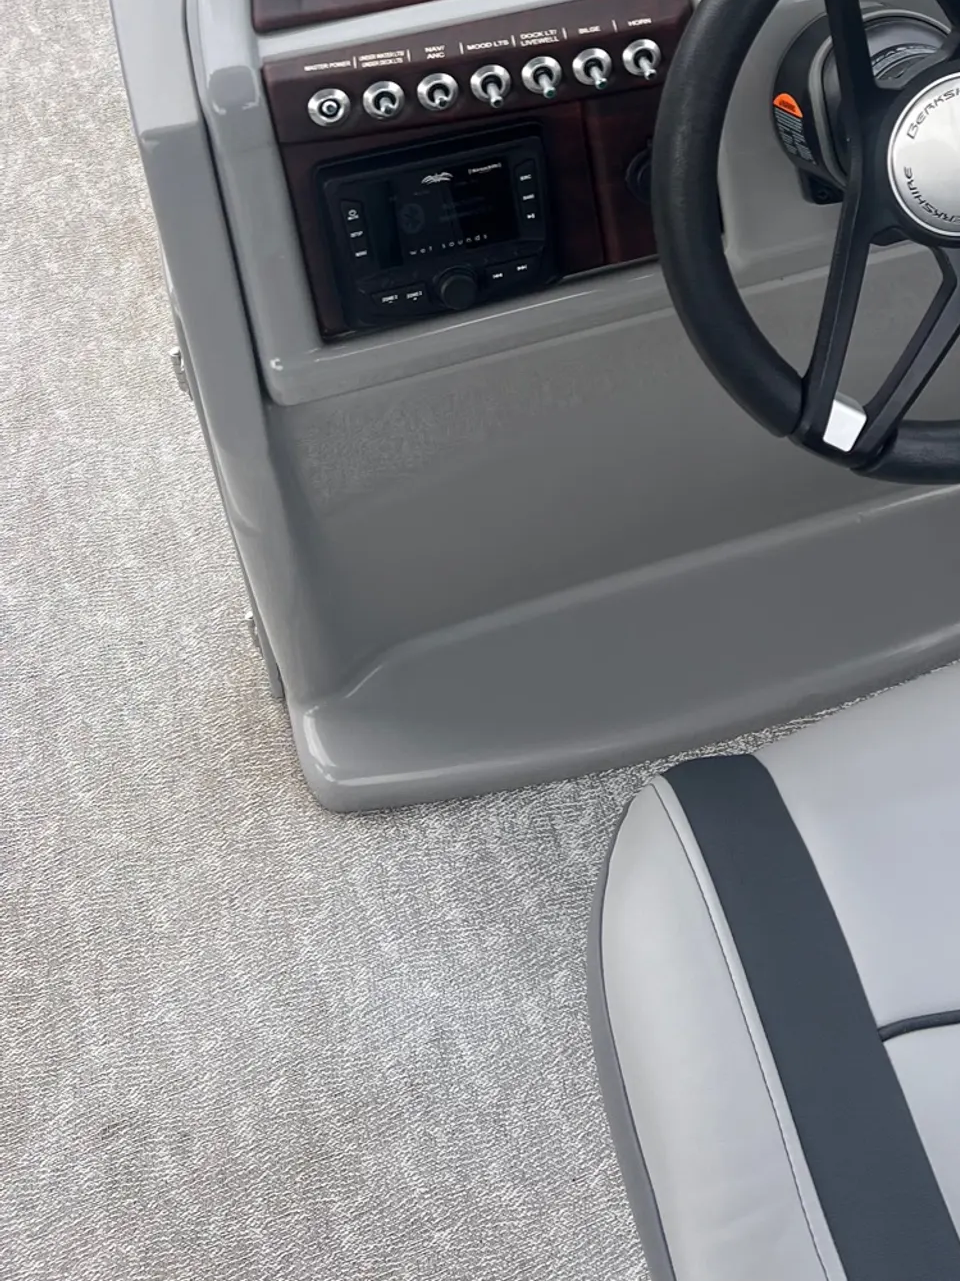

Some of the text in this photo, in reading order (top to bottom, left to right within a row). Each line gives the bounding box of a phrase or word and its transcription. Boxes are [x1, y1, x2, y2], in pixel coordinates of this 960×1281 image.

[578, 26, 602, 35] BILGE
[520, 31, 544, 40] DOCK
[520, 36, 560, 47] LIVEWELL
[467, 42, 493, 51] MOOD
[426, 51, 445, 59] ANC
[329, 60, 351, 69] POWER
[441, 234, 488, 249] sounds
